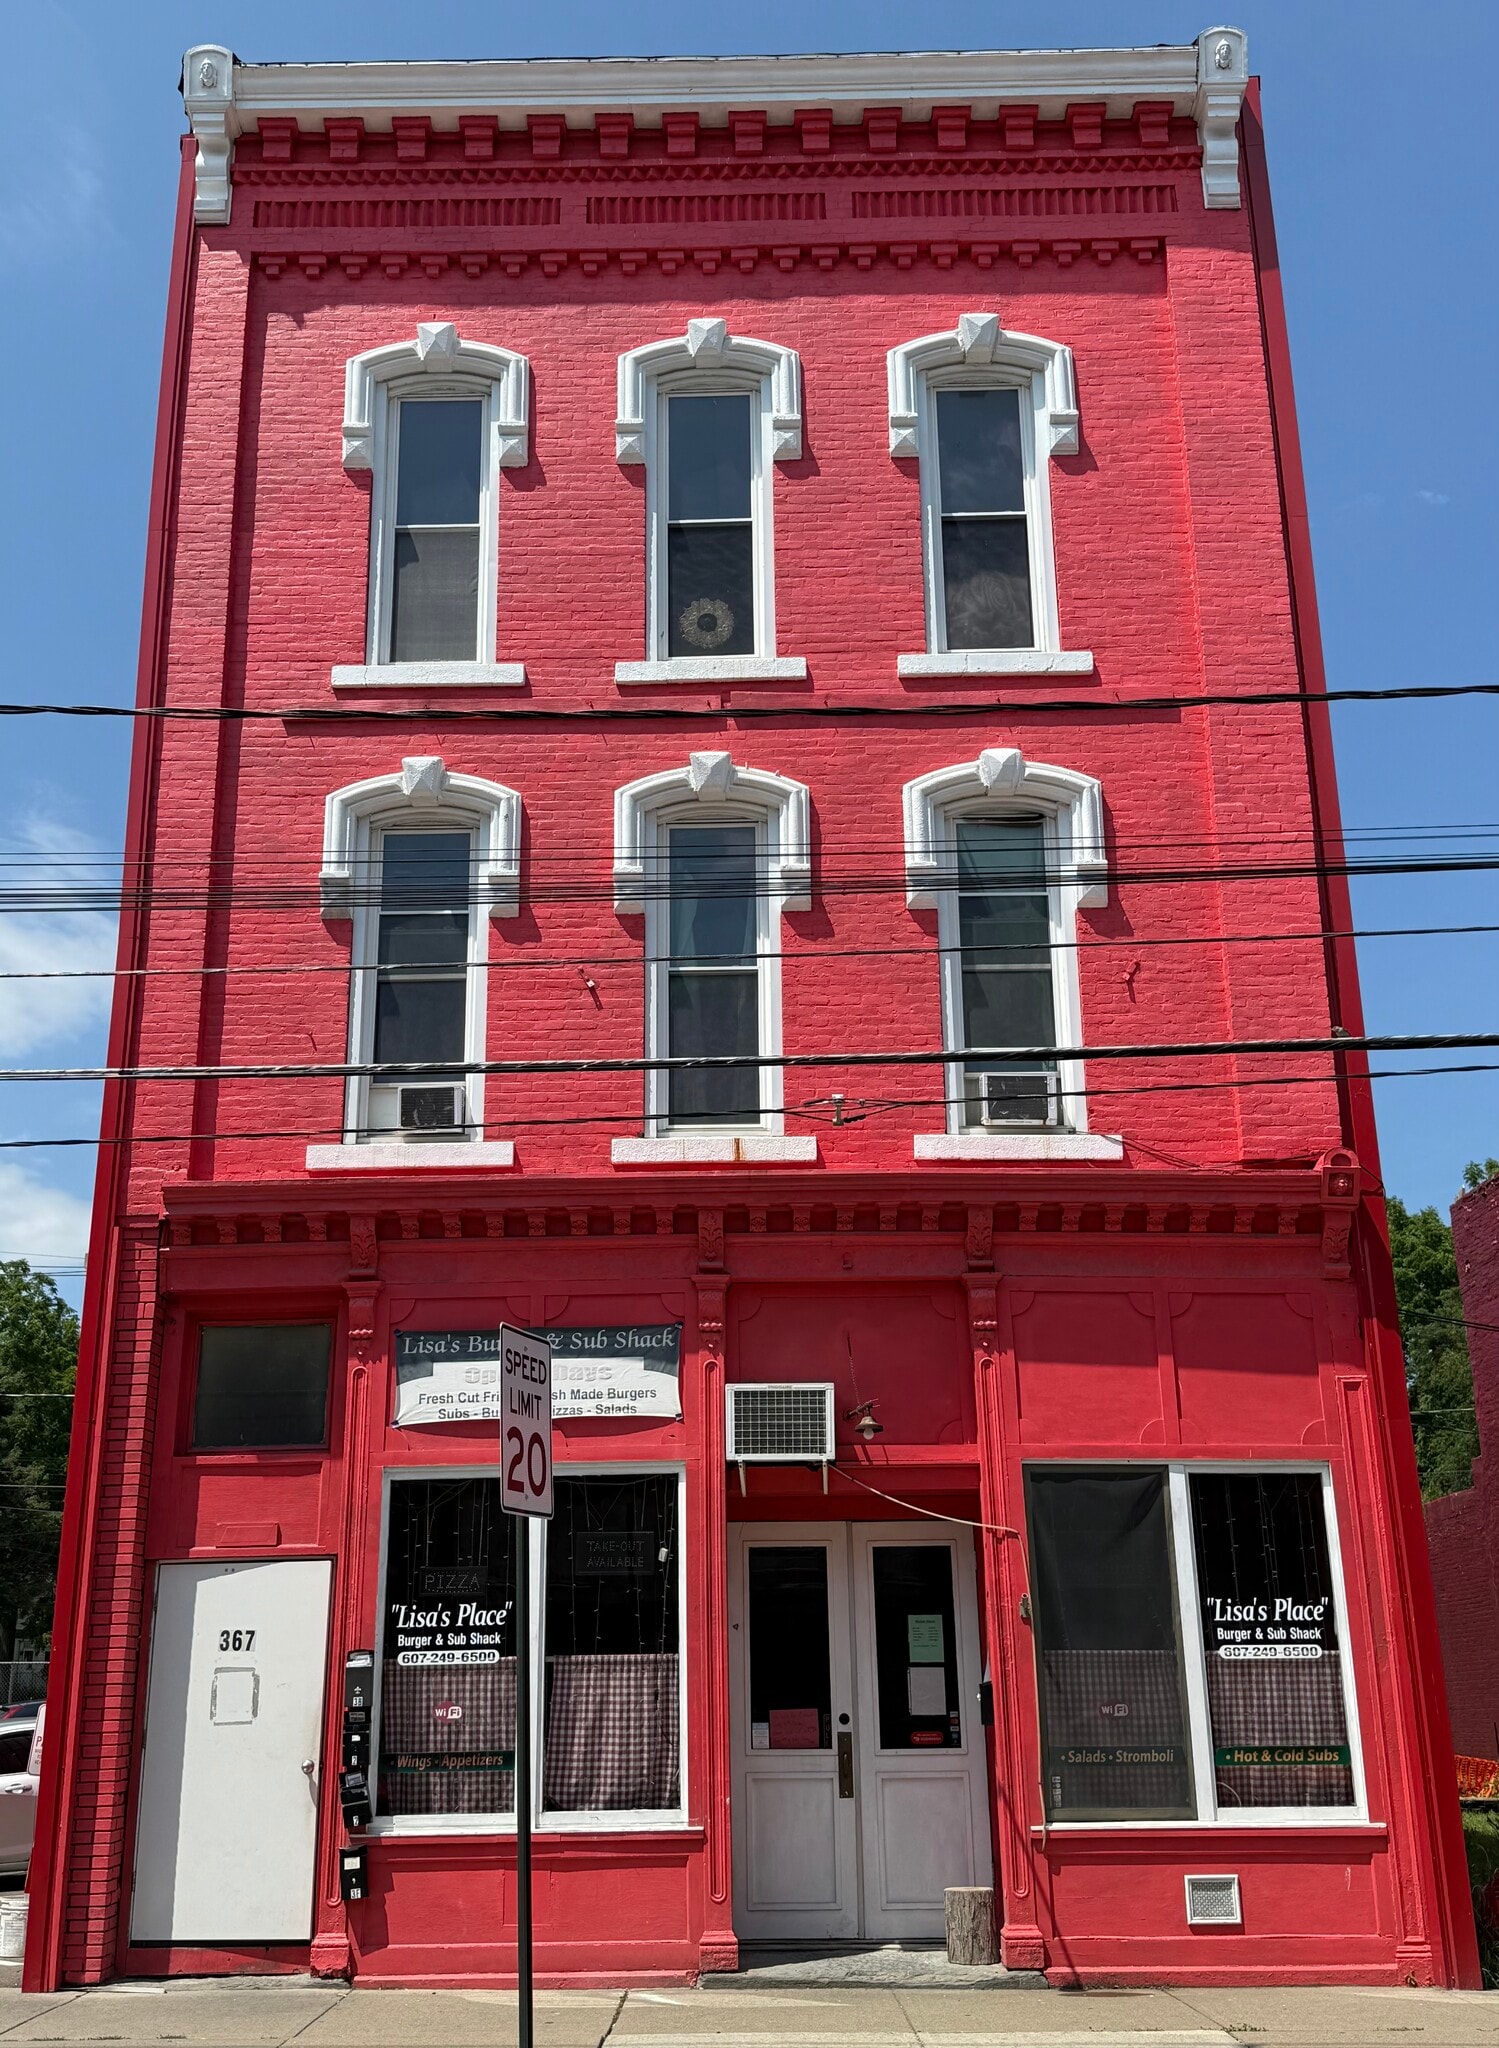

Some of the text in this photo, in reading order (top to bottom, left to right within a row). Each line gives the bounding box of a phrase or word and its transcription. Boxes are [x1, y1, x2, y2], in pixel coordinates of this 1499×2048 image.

[403, 1334, 460, 1354] Lisa's
[547, 1333, 563, 1349] &
[570, 1329, 608, 1349] Sub
[614, 1327, 676, 1348] Shack
[505, 1348, 547, 1385] SPEED
[418, 1393, 454, 1404] Fresh
[458, 1392, 480, 1403] Cut
[483, 1391, 499, 1402] Fri
[570, 1388, 603, 1399] Made
[607, 1387, 657, 1401] Burgers
[509, 1387, 542, 1421] LIMIT
[438, 1408, 470, 1419] Subs
[552, 1405, 583, 1416] izzas
[595, 1403, 637, 1415] Salads
[507, 1426, 546, 1497] 20
[586, 1540, 645, 1552] TAKE-OUT
[586, 1556, 644, 1568] AVAILABLE
[425, 1573, 480, 1589] PIZZA
[391, 1601, 513, 1629] "Lisa's Place"
[1207, 1597, 1328, 1621] "Lisa's Place"
[220, 1629, 255, 1652] 367
[398, 1631, 501, 1649] Burger & Sub Shack
[1216, 1626, 1322, 1642] Burger & Sub Shack
[402, 1651, 496, 1664] 607-249-6500
[1223, 1646, 1319, 1657] 607-249-6500
[397, 1753, 503, 1770] Wings Appetizers
[1068, 1749, 1174, 1763] Salads Stromboli
[1234, 1749, 1339, 1762] Hot & Cold Subs
